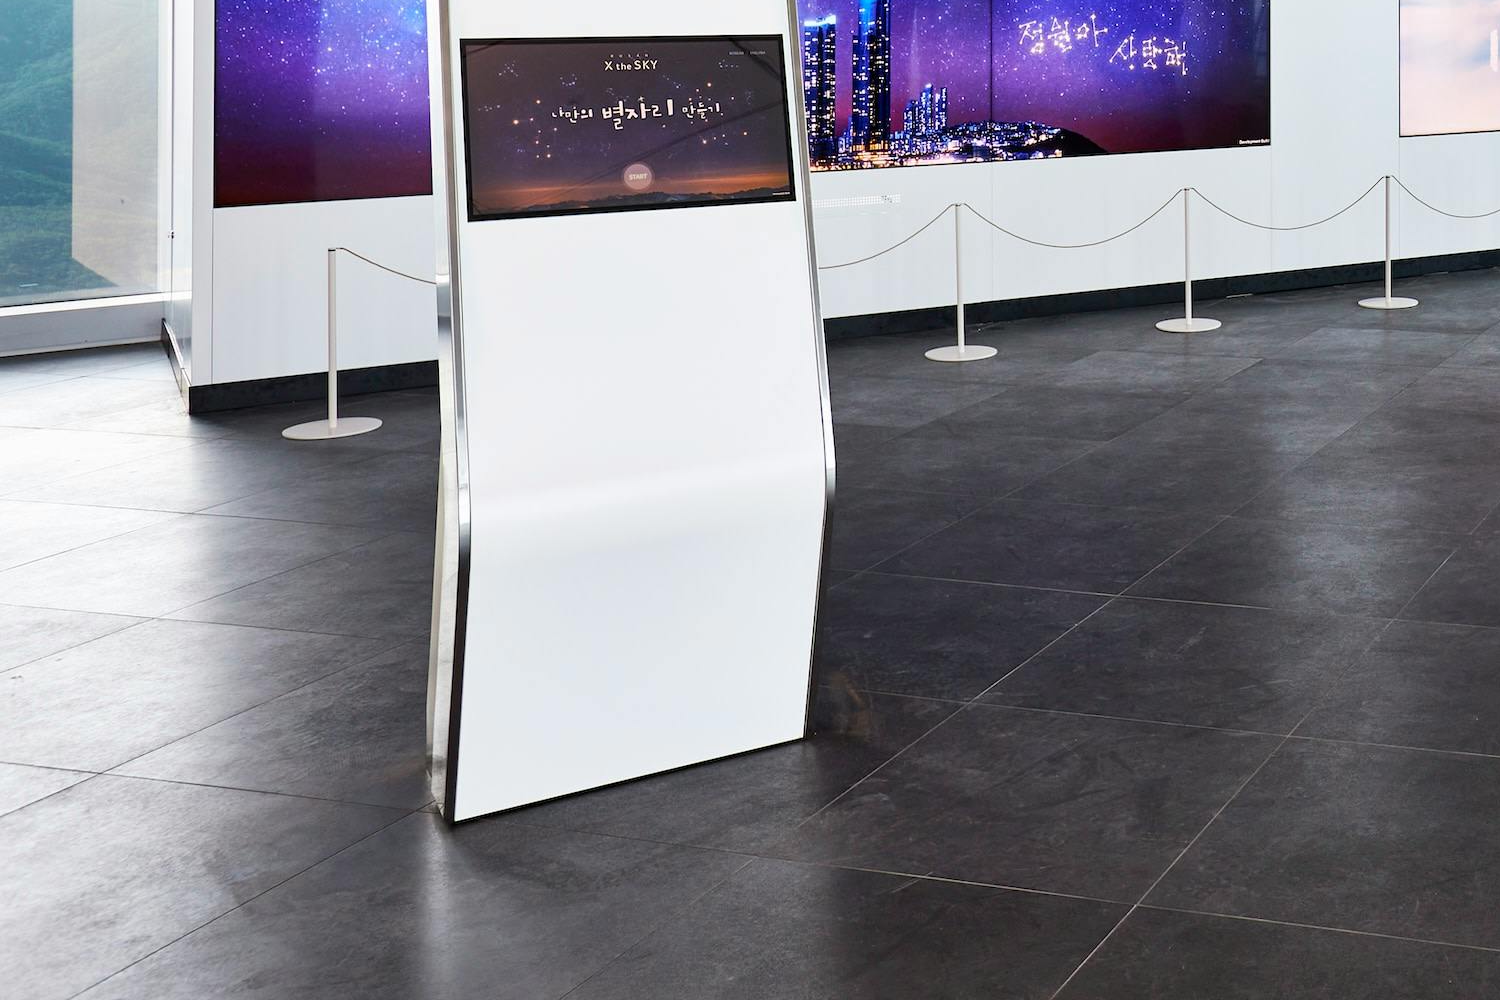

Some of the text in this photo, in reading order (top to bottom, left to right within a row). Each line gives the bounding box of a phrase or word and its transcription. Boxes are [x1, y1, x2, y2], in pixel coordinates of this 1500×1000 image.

[1489, 27, 1499, 73] I
[604, 59, 658, 71] X the SKY
[550, 98, 721, 131] 나만의 별자리 만들기
[628, 173, 648, 181] START
